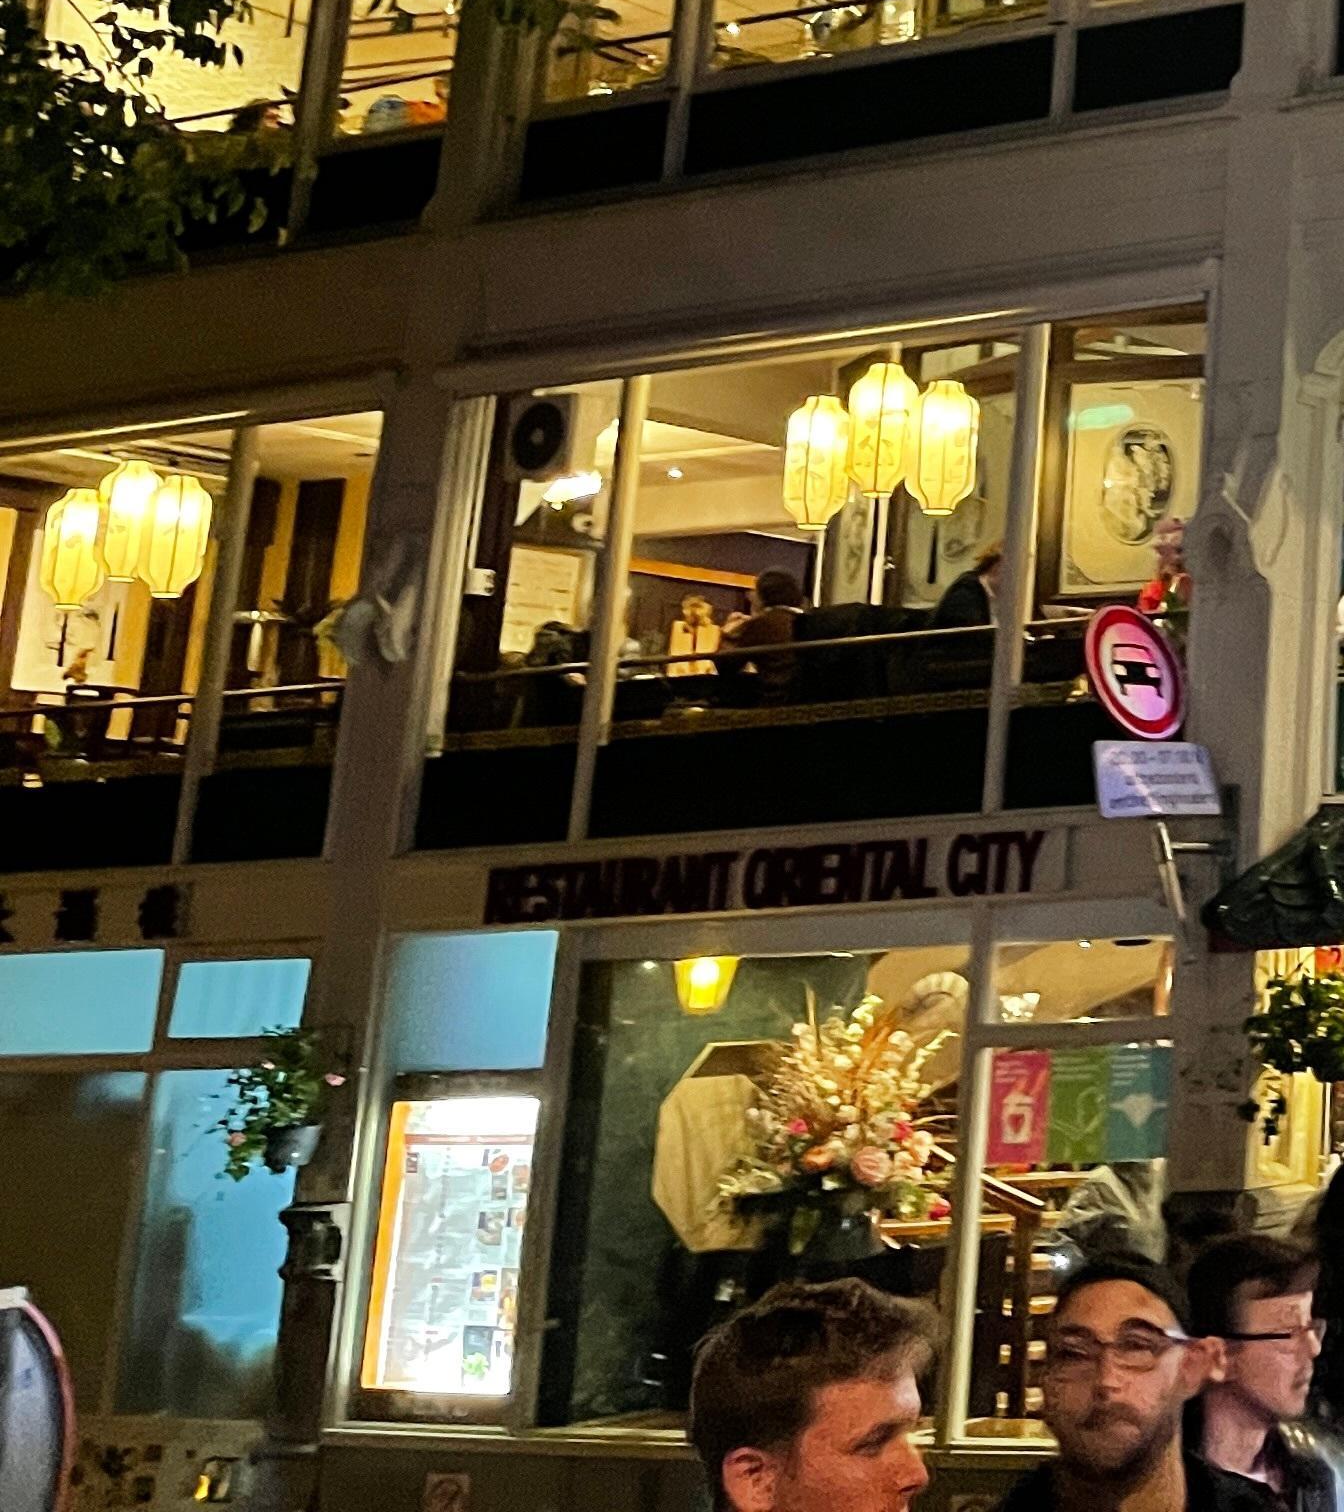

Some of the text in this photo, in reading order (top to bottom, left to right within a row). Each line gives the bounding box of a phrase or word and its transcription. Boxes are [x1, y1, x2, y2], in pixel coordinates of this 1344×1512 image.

[484, 830, 1048, 925] RESTAURANT ORIENTAL CITY
